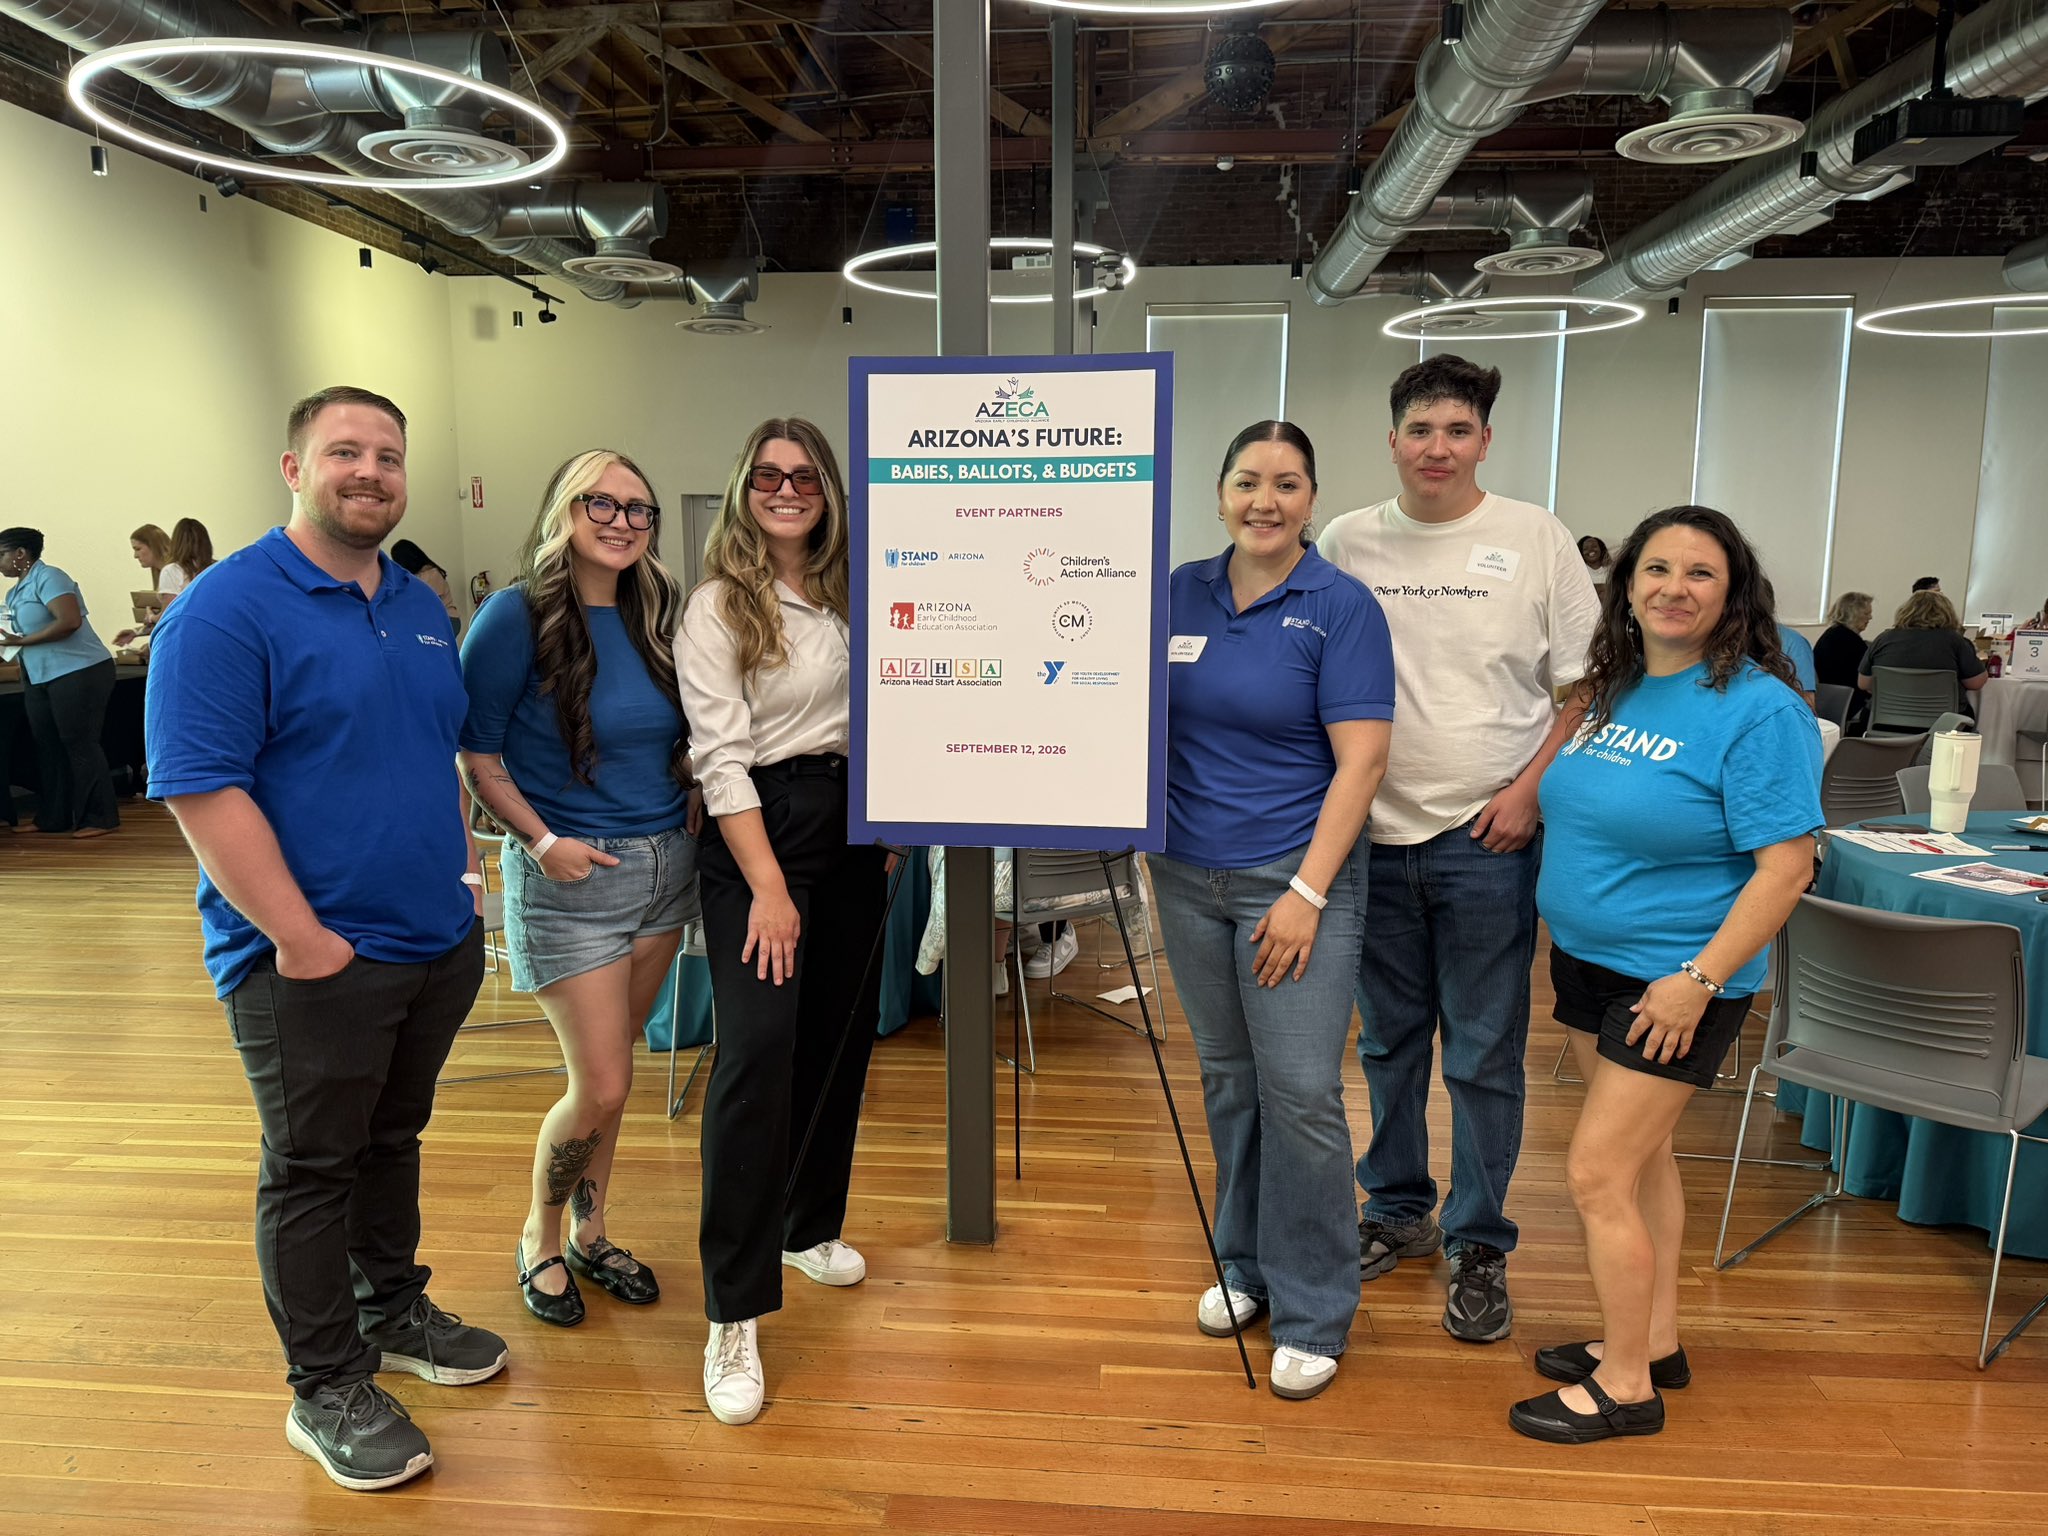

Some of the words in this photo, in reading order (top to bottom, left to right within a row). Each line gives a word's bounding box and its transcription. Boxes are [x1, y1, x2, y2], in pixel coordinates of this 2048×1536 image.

[976, 401, 1049, 417] AZECA
[908, 429, 1030, 448] ARIZONA'S
[1036, 427, 1123, 447] FUTURE:
[891, 464, 953, 482] BABIES,
[958, 464, 1038, 481] BALLOTS,
[1042, 464, 1056, 479] &
[1060, 462, 1137, 479] BUDGETS
[955, 508, 995, 518] EVENT
[998, 507, 1063, 518] PARTNERS
[901, 551, 939, 561] STAND
[1060, 556, 1110, 566] Children's
[1477, 562, 1507, 572] VOLUNTEER
[1060, 568, 1094, 578] Action
[1095, 568, 1137, 578] Alliance
[1374, 586, 1401, 596] New
[1401, 585, 1430, 598] York
[1441, 585, 1489, 598] Nowhere
[917, 603, 972, 612] ARIZONA
[917, 614, 937, 623] Early
[938, 614, 977, 622] Childhood
[1059, 614, 1085, 628] CM
[917, 623, 954, 631] Education
[955, 623, 998, 631] Association
[2030, 646, 2039, 658] 3
[880, 678, 911, 686] Arizona
[912, 678, 933, 686] Head
[935, 678, 955, 686] Start
[956, 679, 1002, 687] Association
[1593, 722, 1678, 761] STAND
[946, 743, 1018, 754] SEPTEMBER
[1020, 745, 1035, 755] 12,
[1038, 745, 1067, 755] 2026
[1582, 744, 1597, 756] for
[1596, 748, 1632, 766] children
